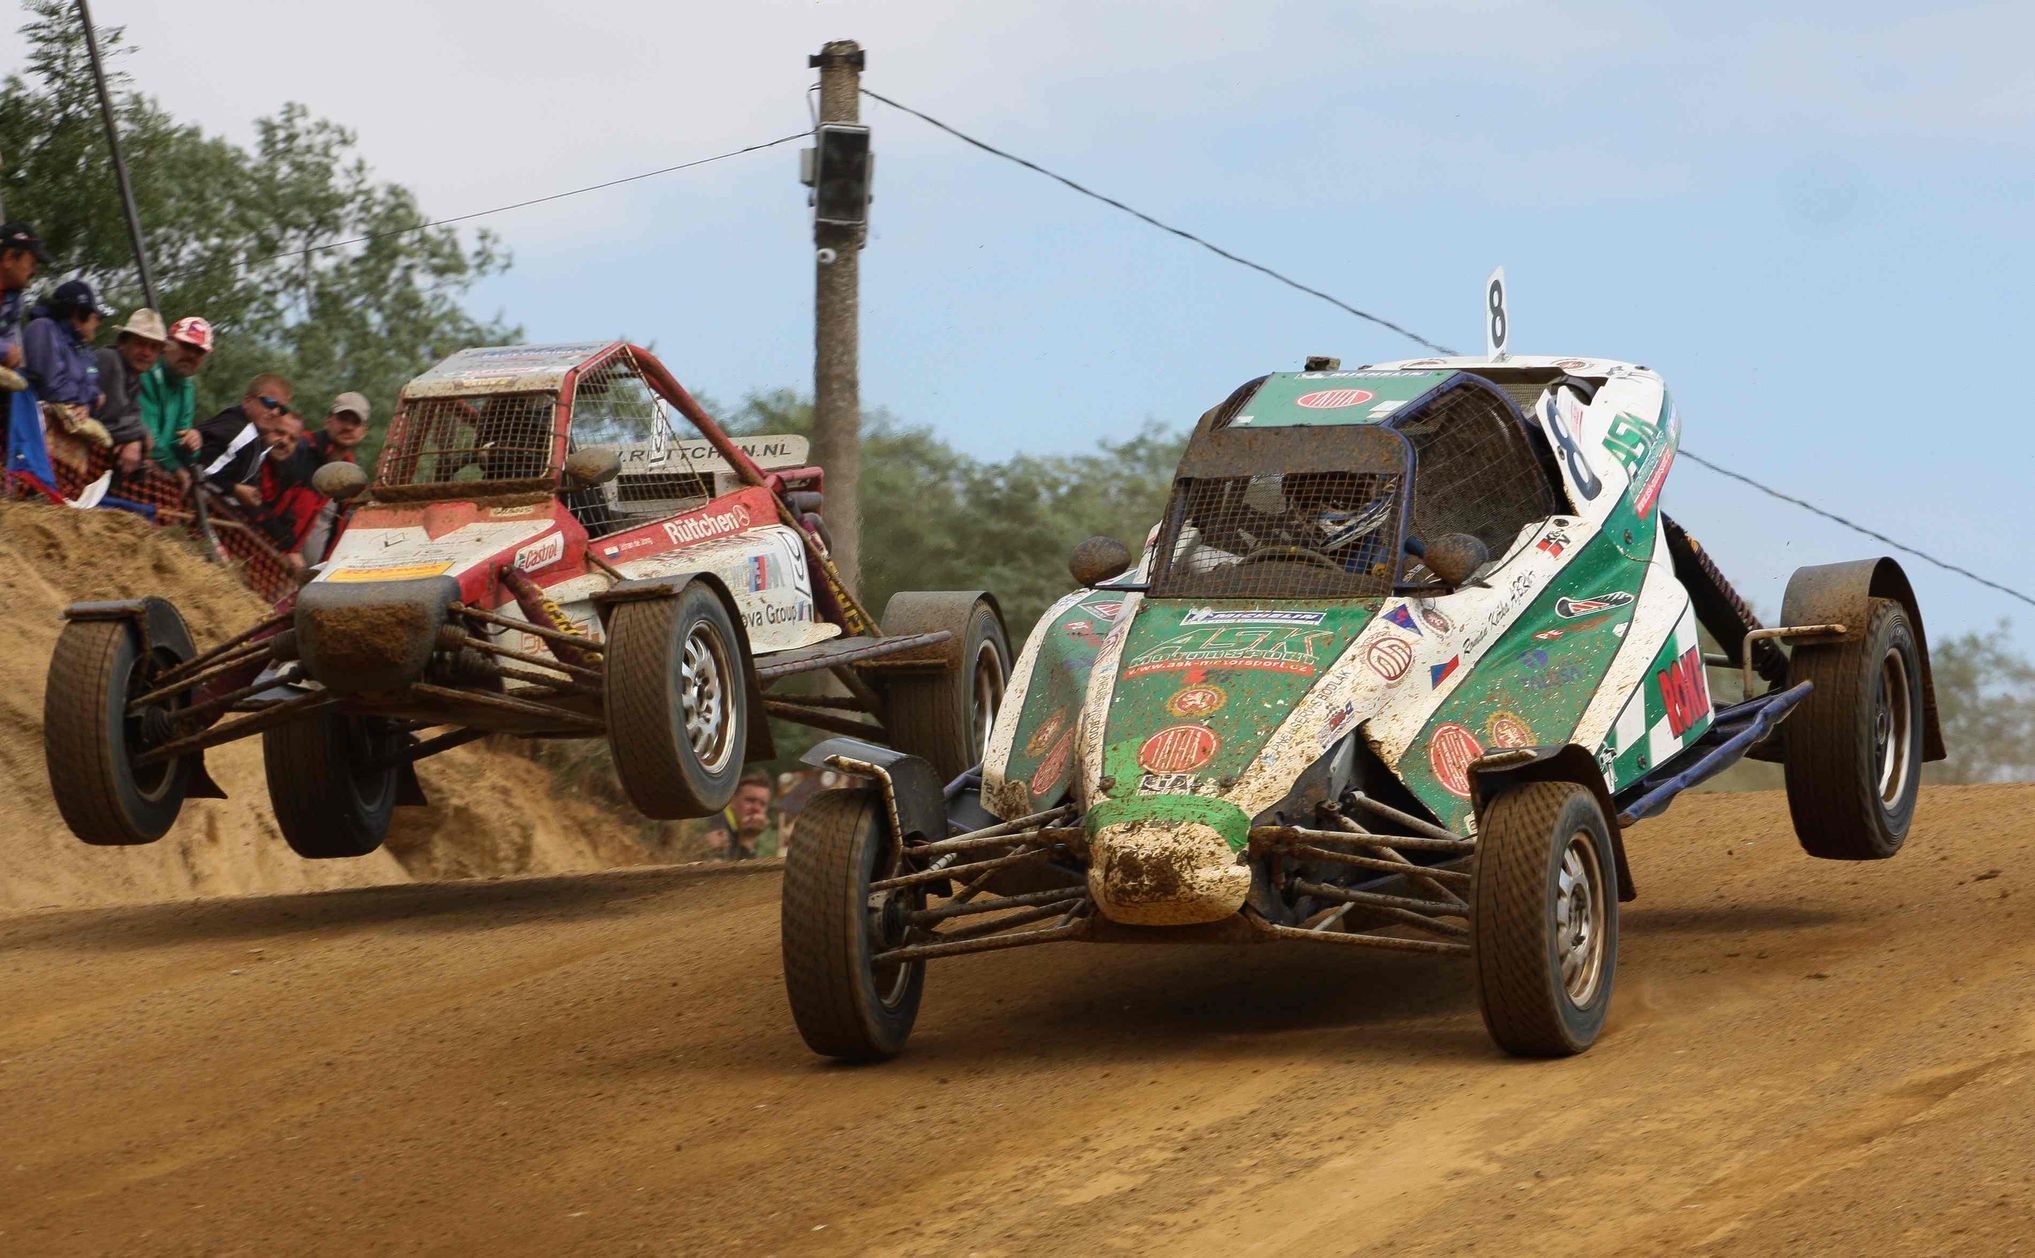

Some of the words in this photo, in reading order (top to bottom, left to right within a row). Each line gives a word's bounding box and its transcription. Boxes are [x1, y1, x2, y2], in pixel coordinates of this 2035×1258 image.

[1489, 279, 1506, 349] 8
[1546, 397, 1602, 501] 8
[663, 513, 740, 545] Rüttchen
[525, 538, 558, 569] Castrol
[766, 603, 798, 626] Group
[1212, 611, 1320, 621] MICHELIN
